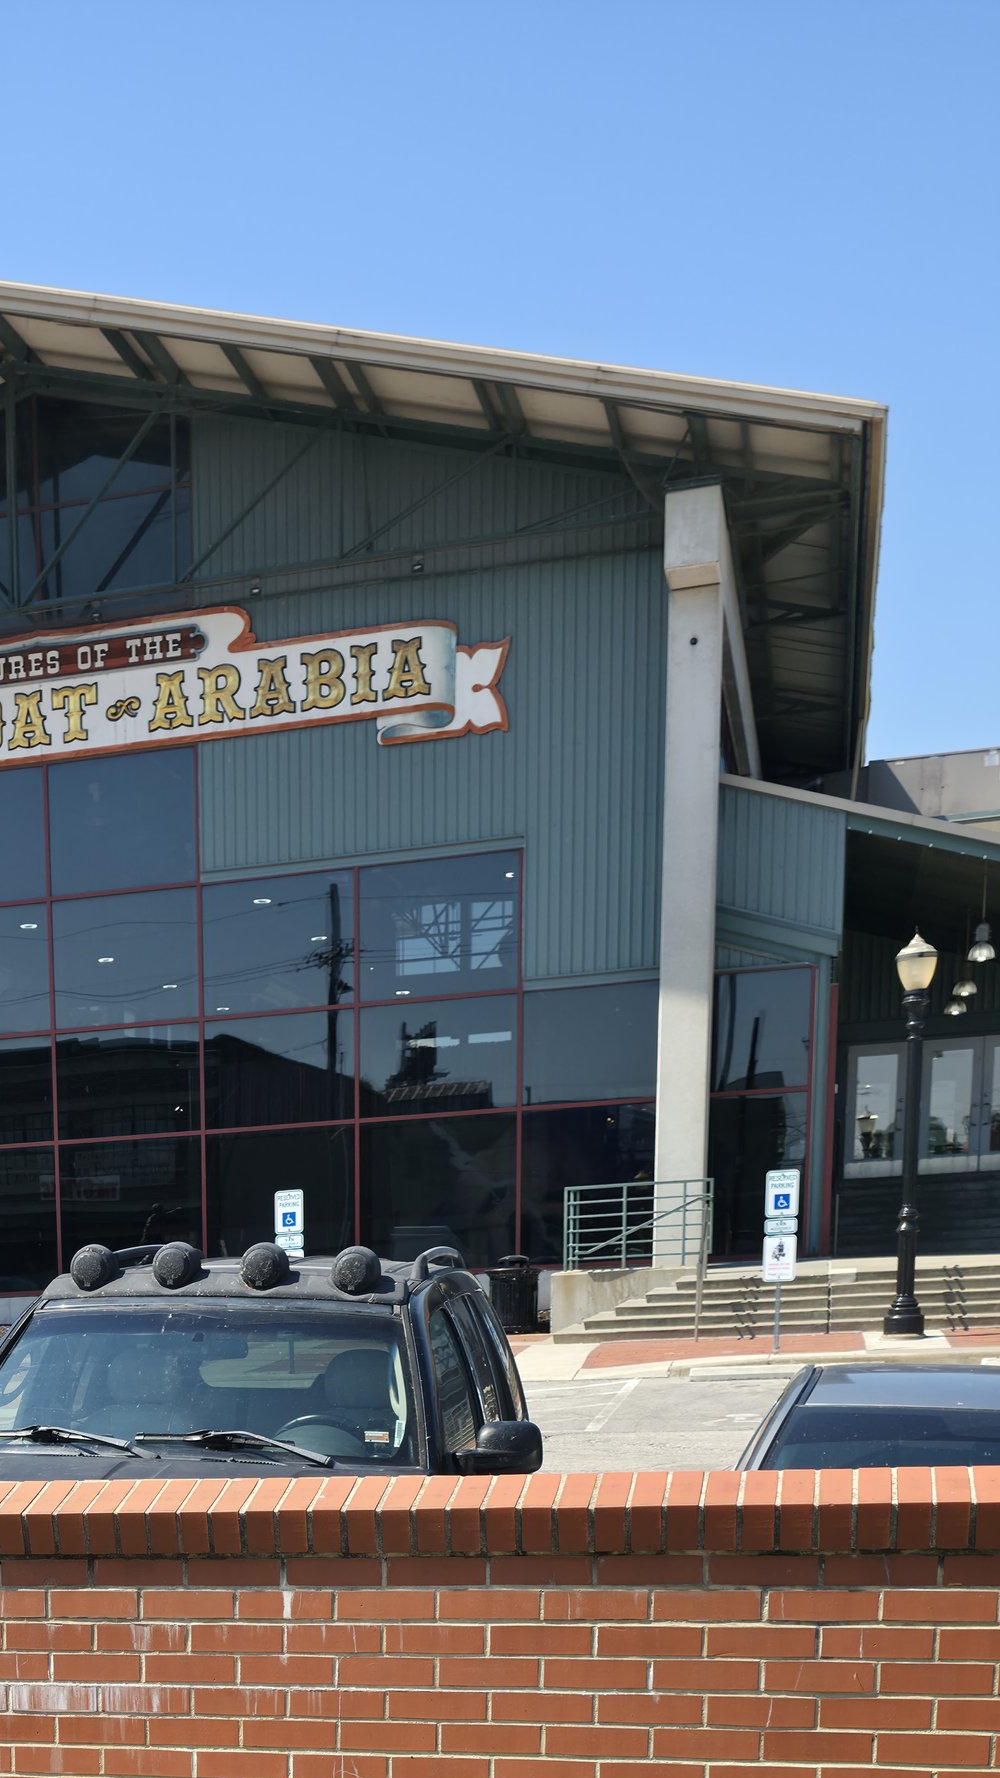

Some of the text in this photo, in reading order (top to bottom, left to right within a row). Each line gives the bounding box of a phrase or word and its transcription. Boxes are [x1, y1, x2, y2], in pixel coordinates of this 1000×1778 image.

[76, 643, 109, 669] OF
[125, 632, 182, 663] THE
[148, 636, 431, 732] ARABIA
